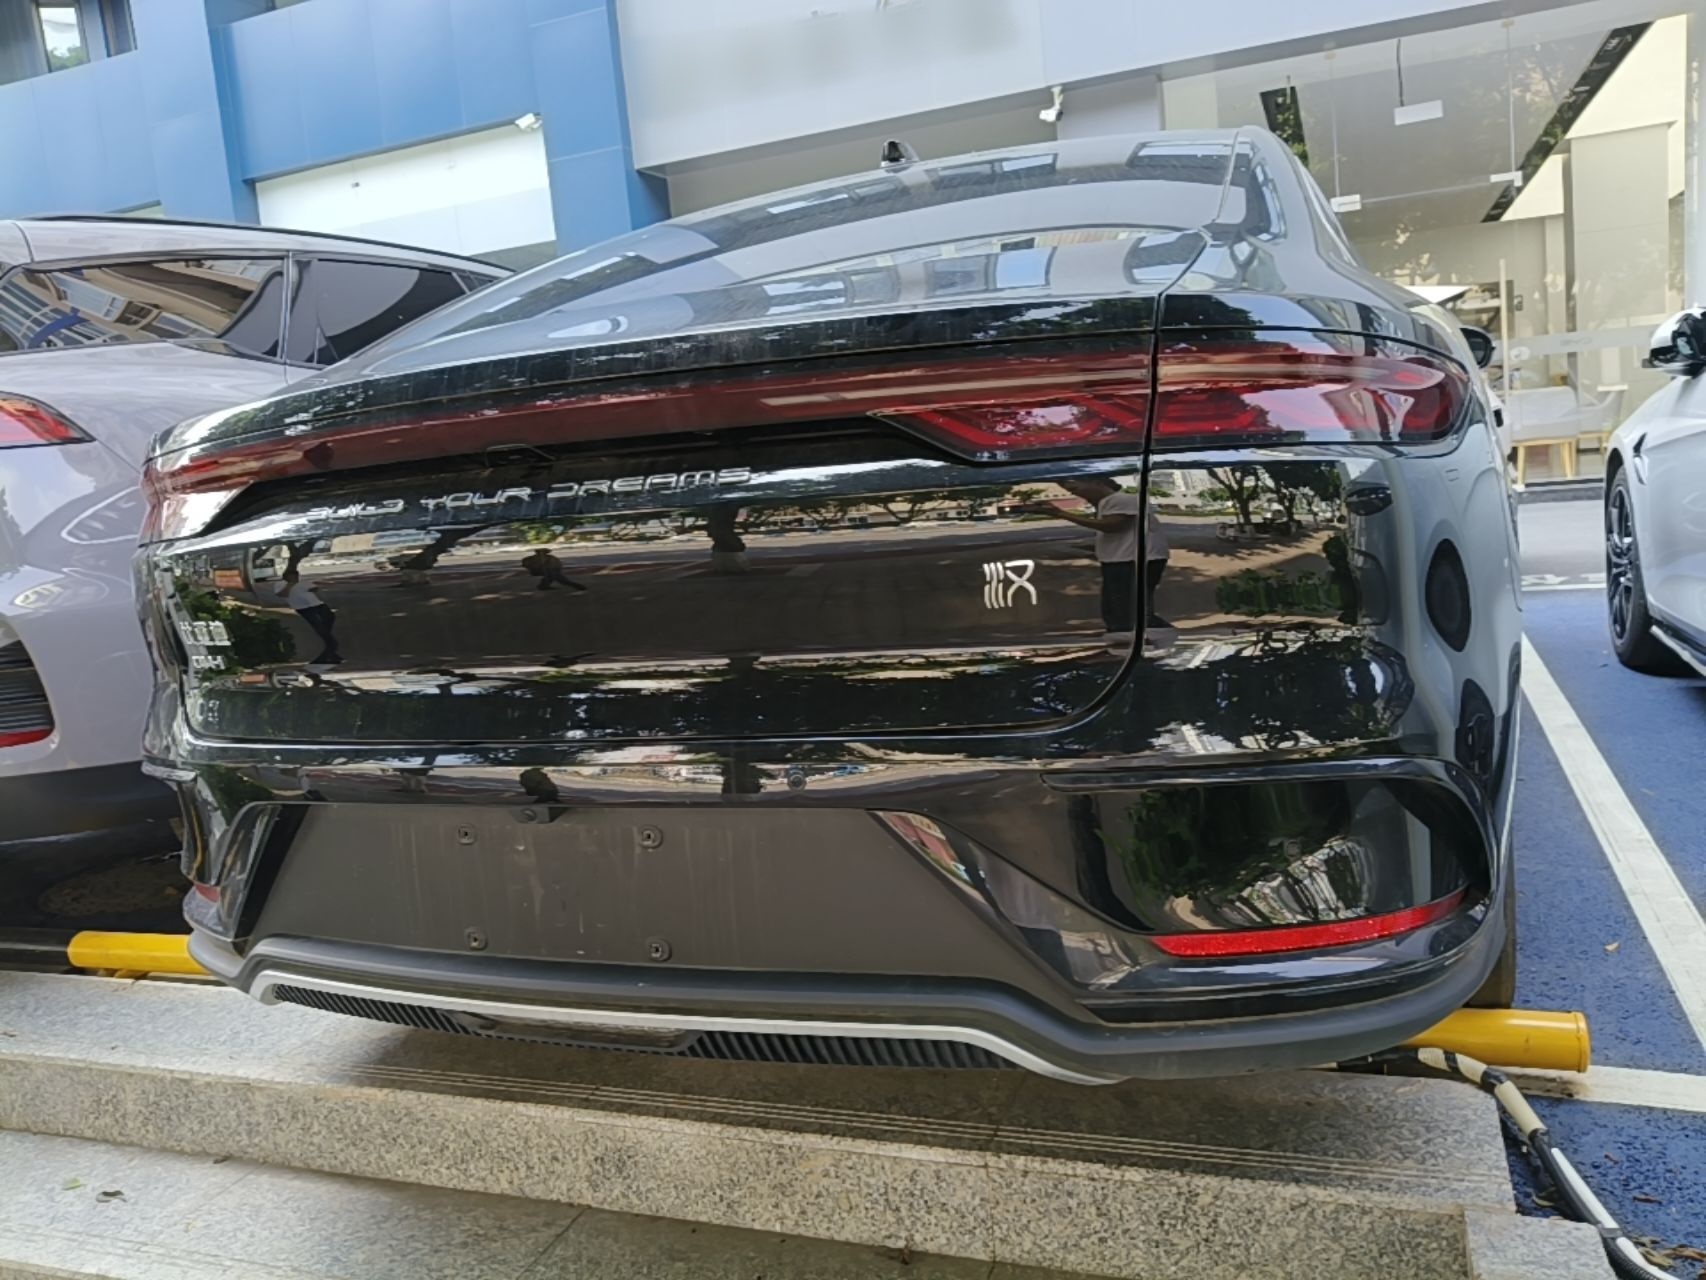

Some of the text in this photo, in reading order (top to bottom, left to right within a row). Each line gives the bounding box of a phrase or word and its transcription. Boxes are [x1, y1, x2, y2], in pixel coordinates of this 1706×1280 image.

[306, 466, 751, 520] BUILD YOUR DREAMS
